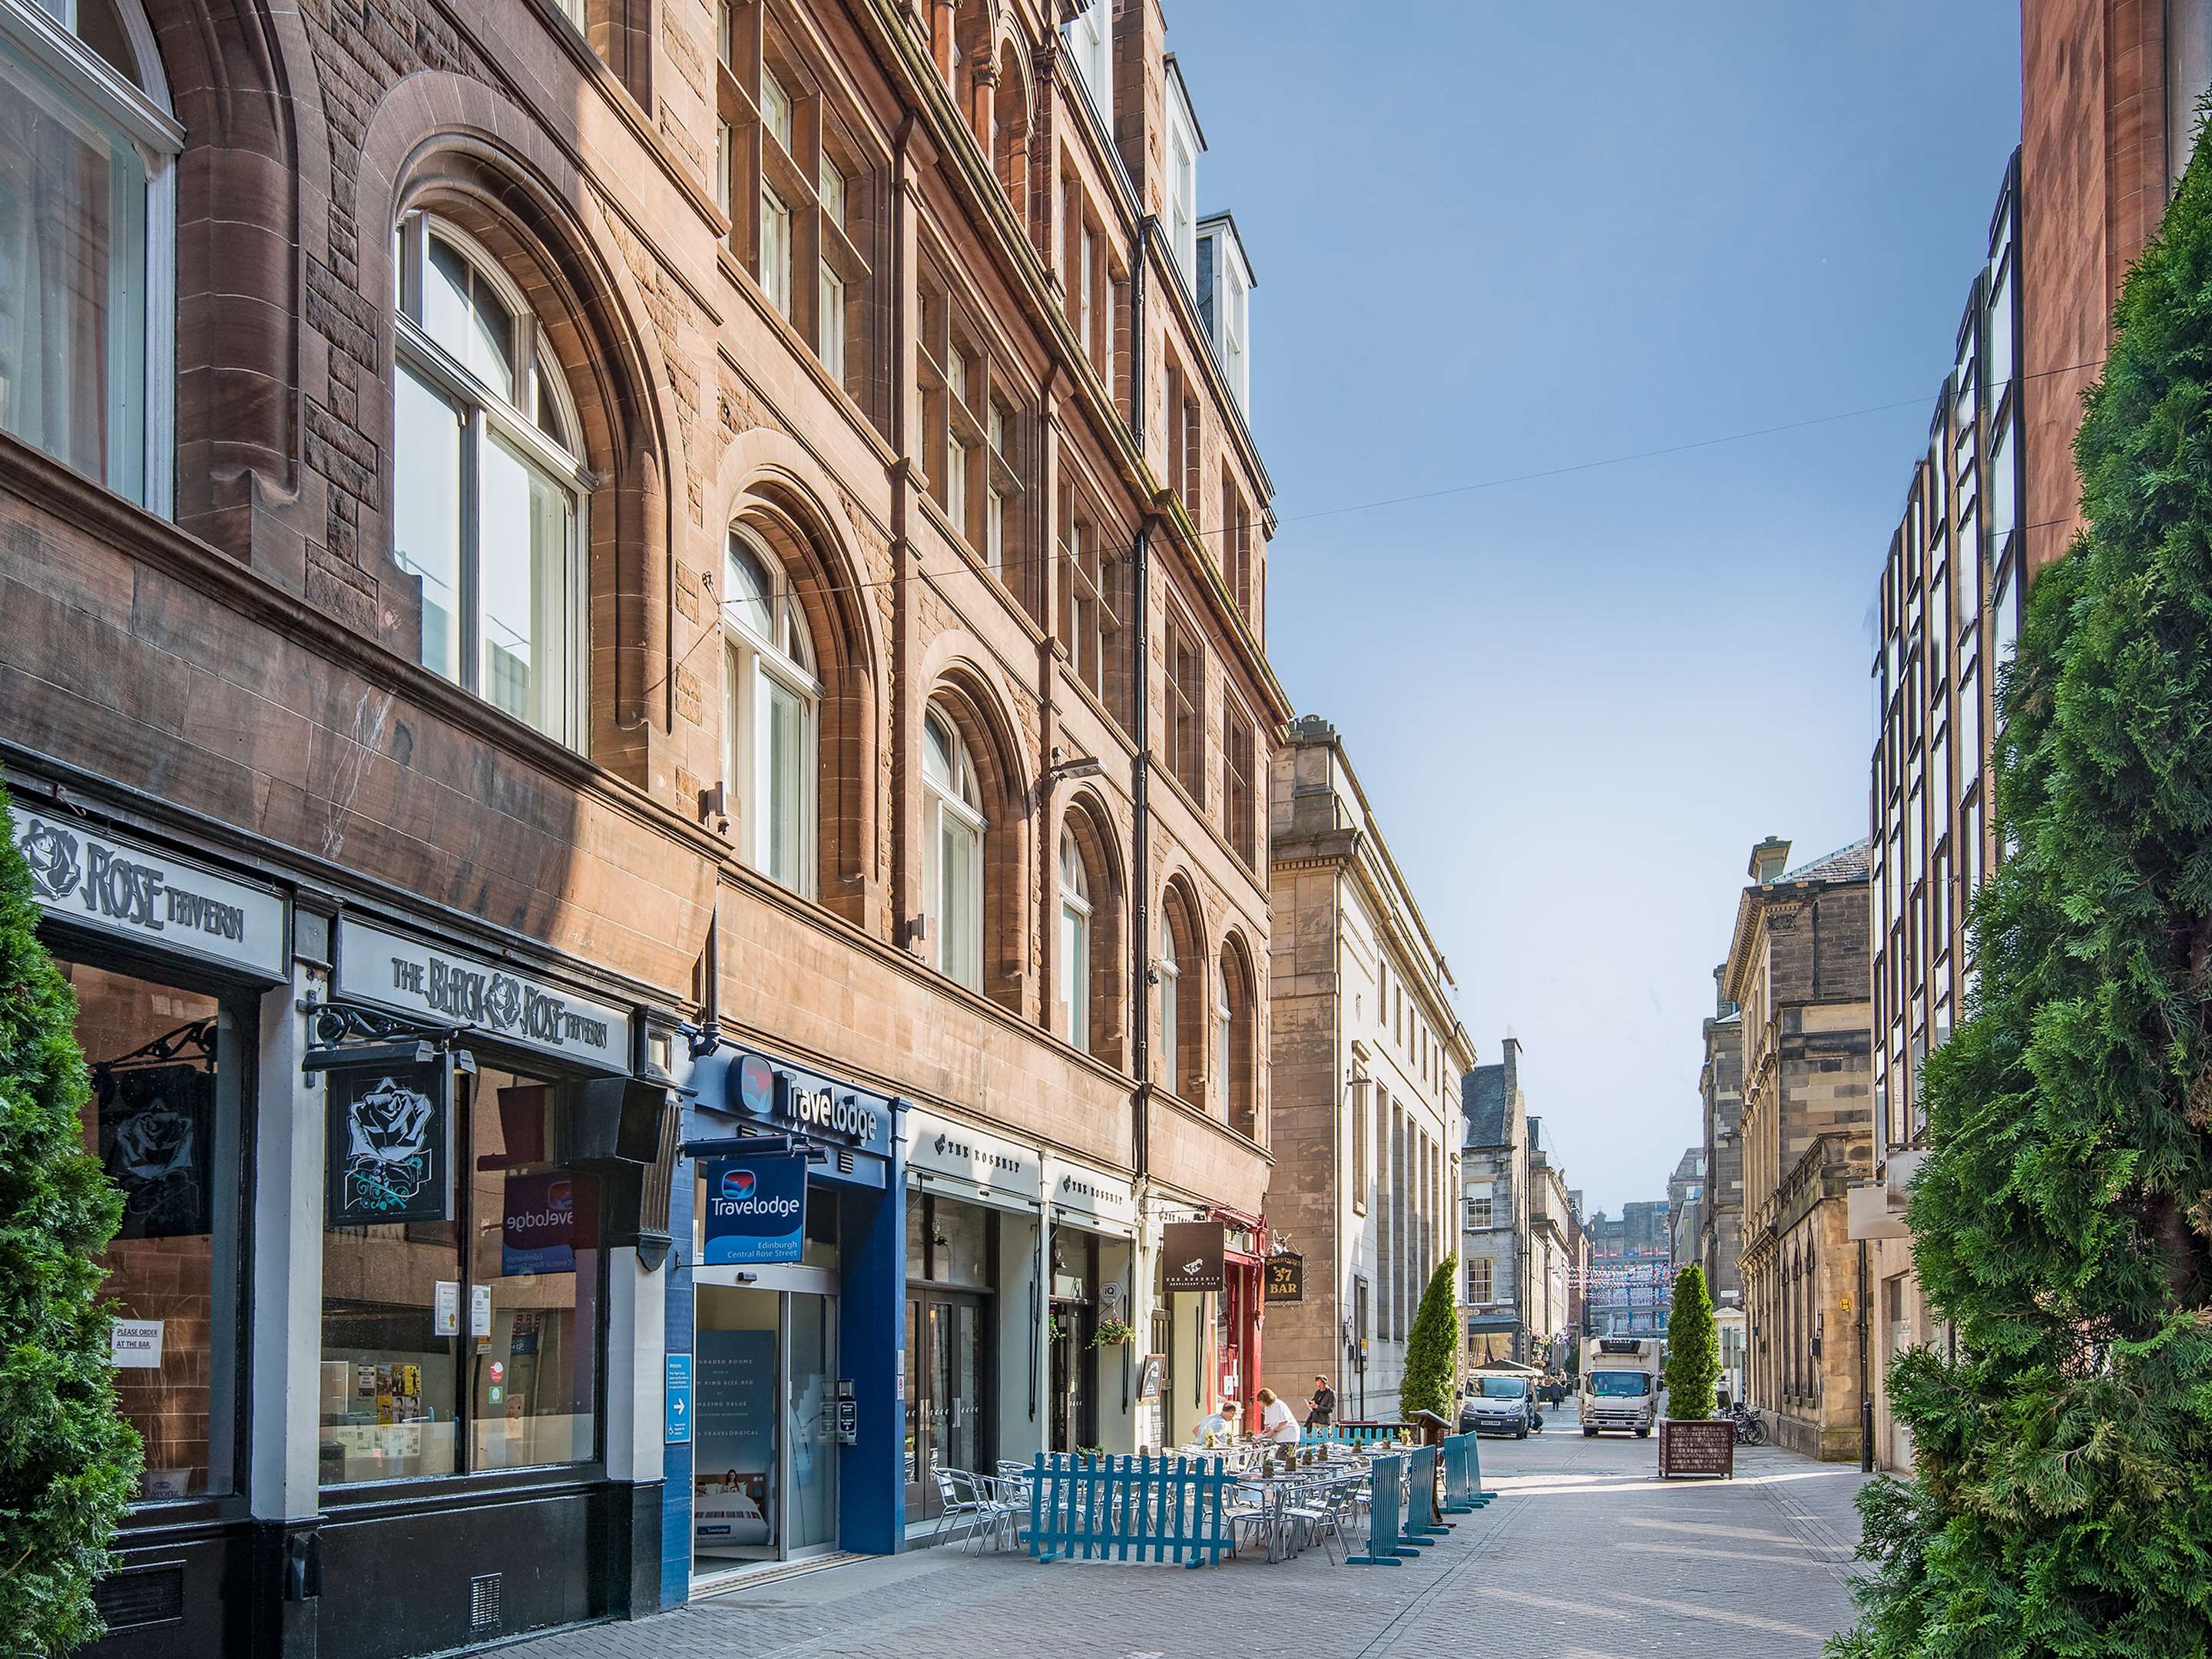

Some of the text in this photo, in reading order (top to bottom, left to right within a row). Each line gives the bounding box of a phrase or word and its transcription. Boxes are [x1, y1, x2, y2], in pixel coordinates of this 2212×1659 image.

[80, 842, 244, 942] ROSE TAVERN
[392, 957, 608, 1049] THE BLACK ROSE TAVERN
[782, 1070, 878, 1147] Travelodge
[949, 1141, 1020, 1173] THE ROSEHIP
[711, 1196, 800, 1217] Travelodge
[1072, 1181, 1122, 1205] THE ROSEHIP
[1270, 1283, 1296, 1293] BAR
[1274, 1267, 1292, 1282] 37
